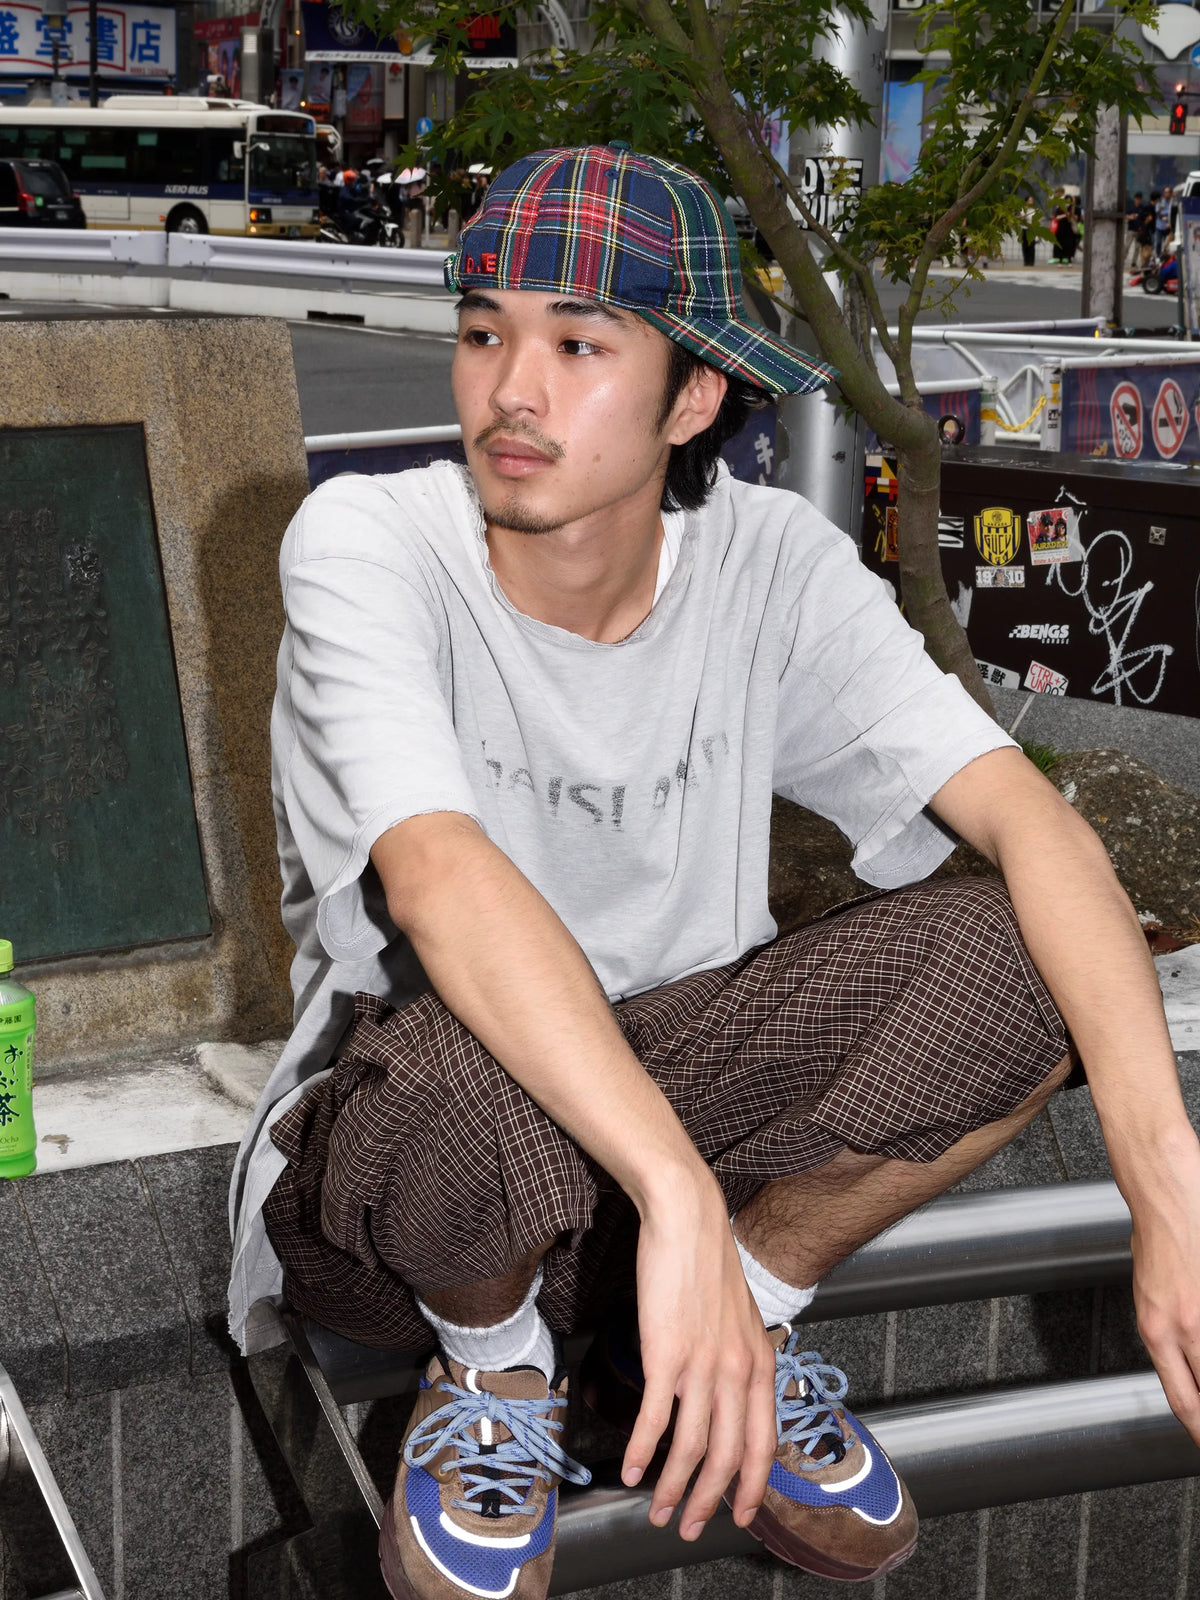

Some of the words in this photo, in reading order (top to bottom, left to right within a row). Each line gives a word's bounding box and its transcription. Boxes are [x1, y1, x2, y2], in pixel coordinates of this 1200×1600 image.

[165, 184, 188, 194] KEIO
[188, 186, 209, 195] BUS
[1020, 623, 1070, 640] BENGS
[1030, 663, 1067, 690] CTRL+Z
[1030, 675, 1059, 696] UNDO
